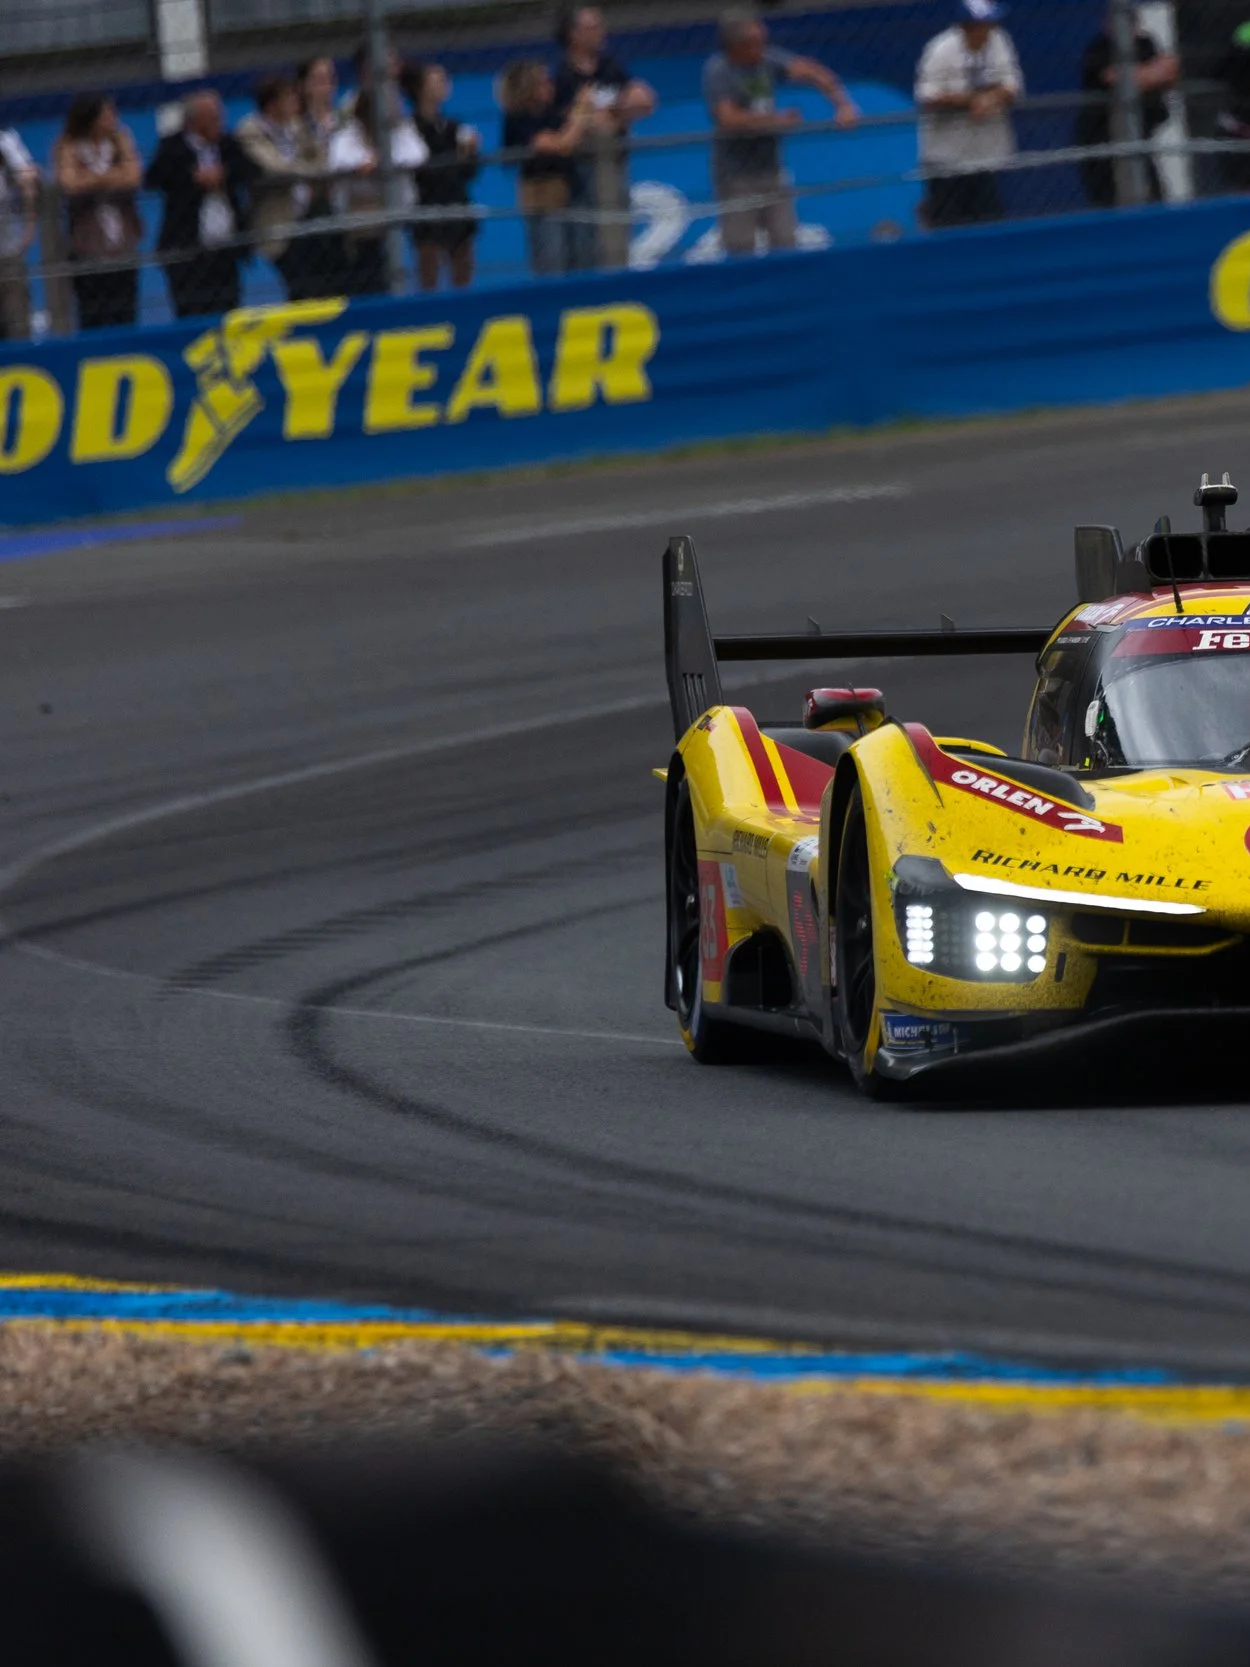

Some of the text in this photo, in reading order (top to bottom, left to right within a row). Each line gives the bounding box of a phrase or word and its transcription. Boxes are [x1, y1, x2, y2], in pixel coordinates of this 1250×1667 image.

[951, 770, 1054, 815] ORLEN
[971, 848, 1213, 891] RICHARD MILLE
